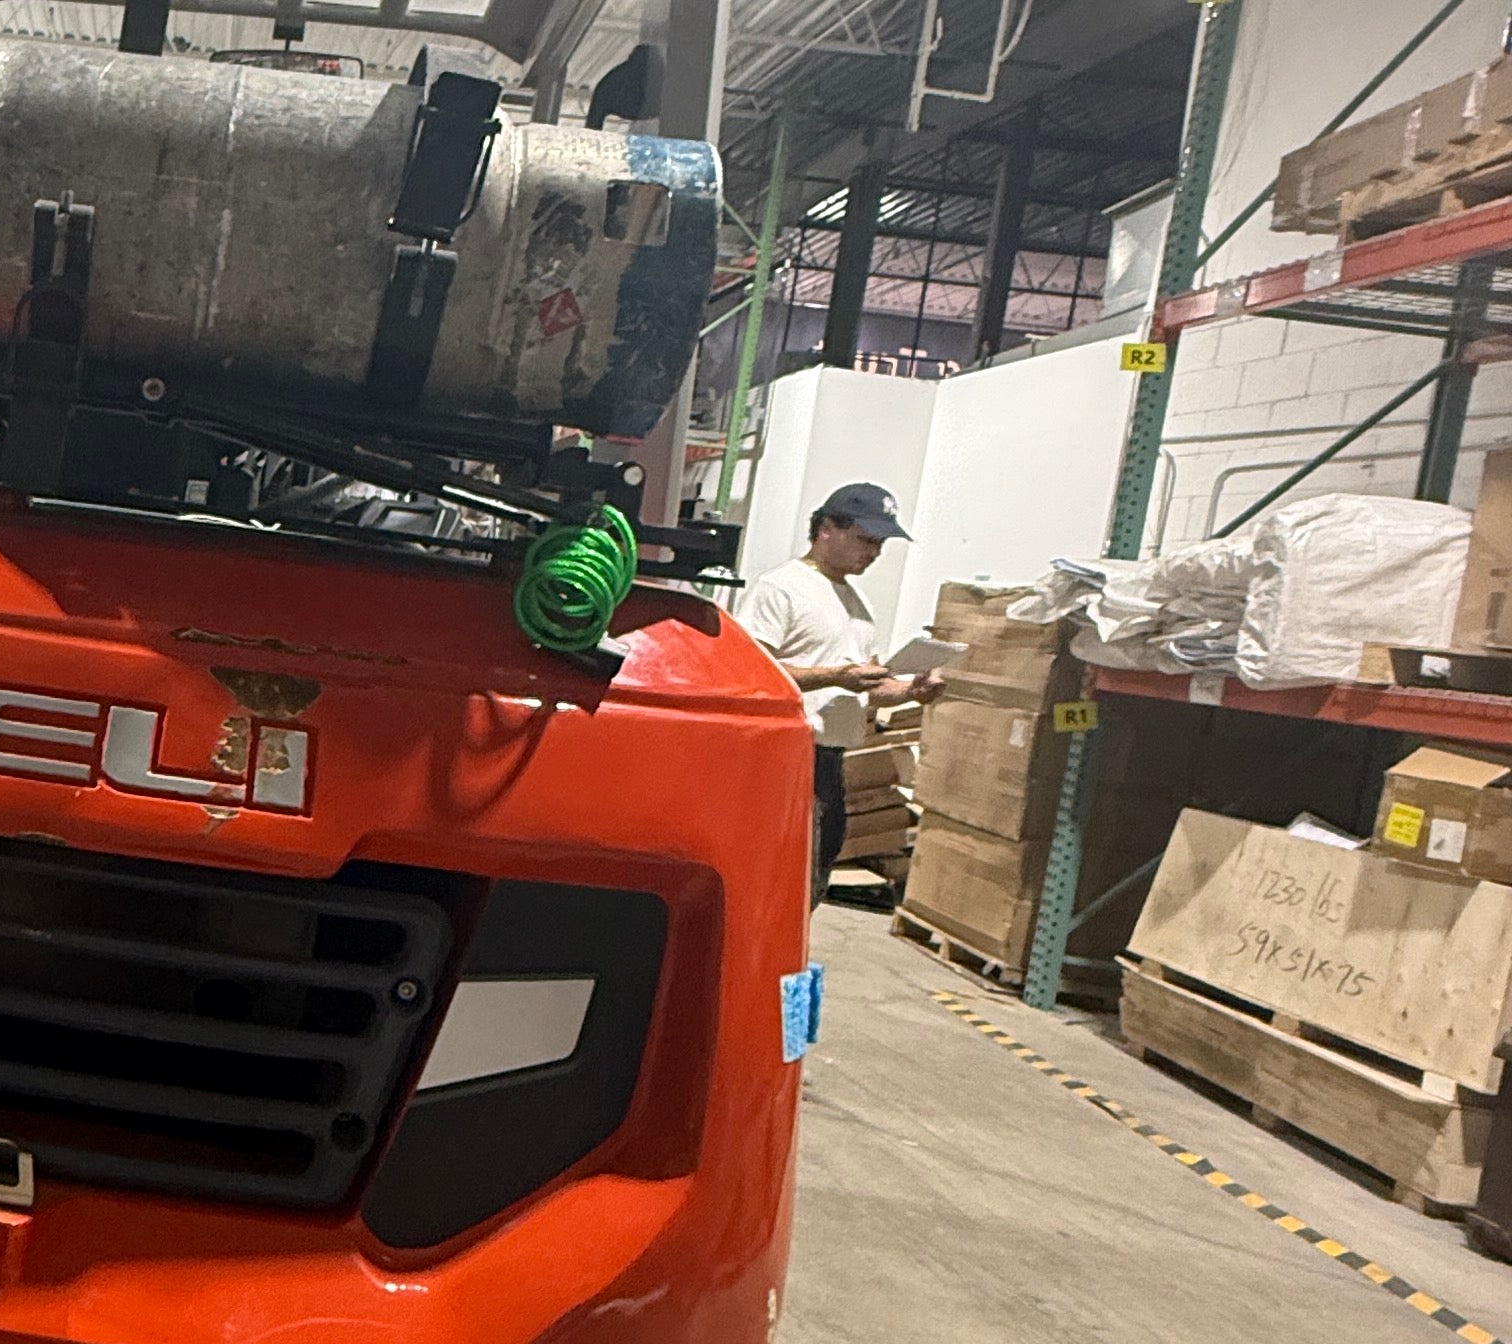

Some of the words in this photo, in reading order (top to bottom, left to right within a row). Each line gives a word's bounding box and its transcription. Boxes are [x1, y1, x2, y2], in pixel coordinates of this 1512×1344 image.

[1130, 349, 1156, 365] R2
[1065, 709, 1087, 725] R1
[1253, 869, 1307, 907] 1230
[1308, 870, 1345, 924] lbs
